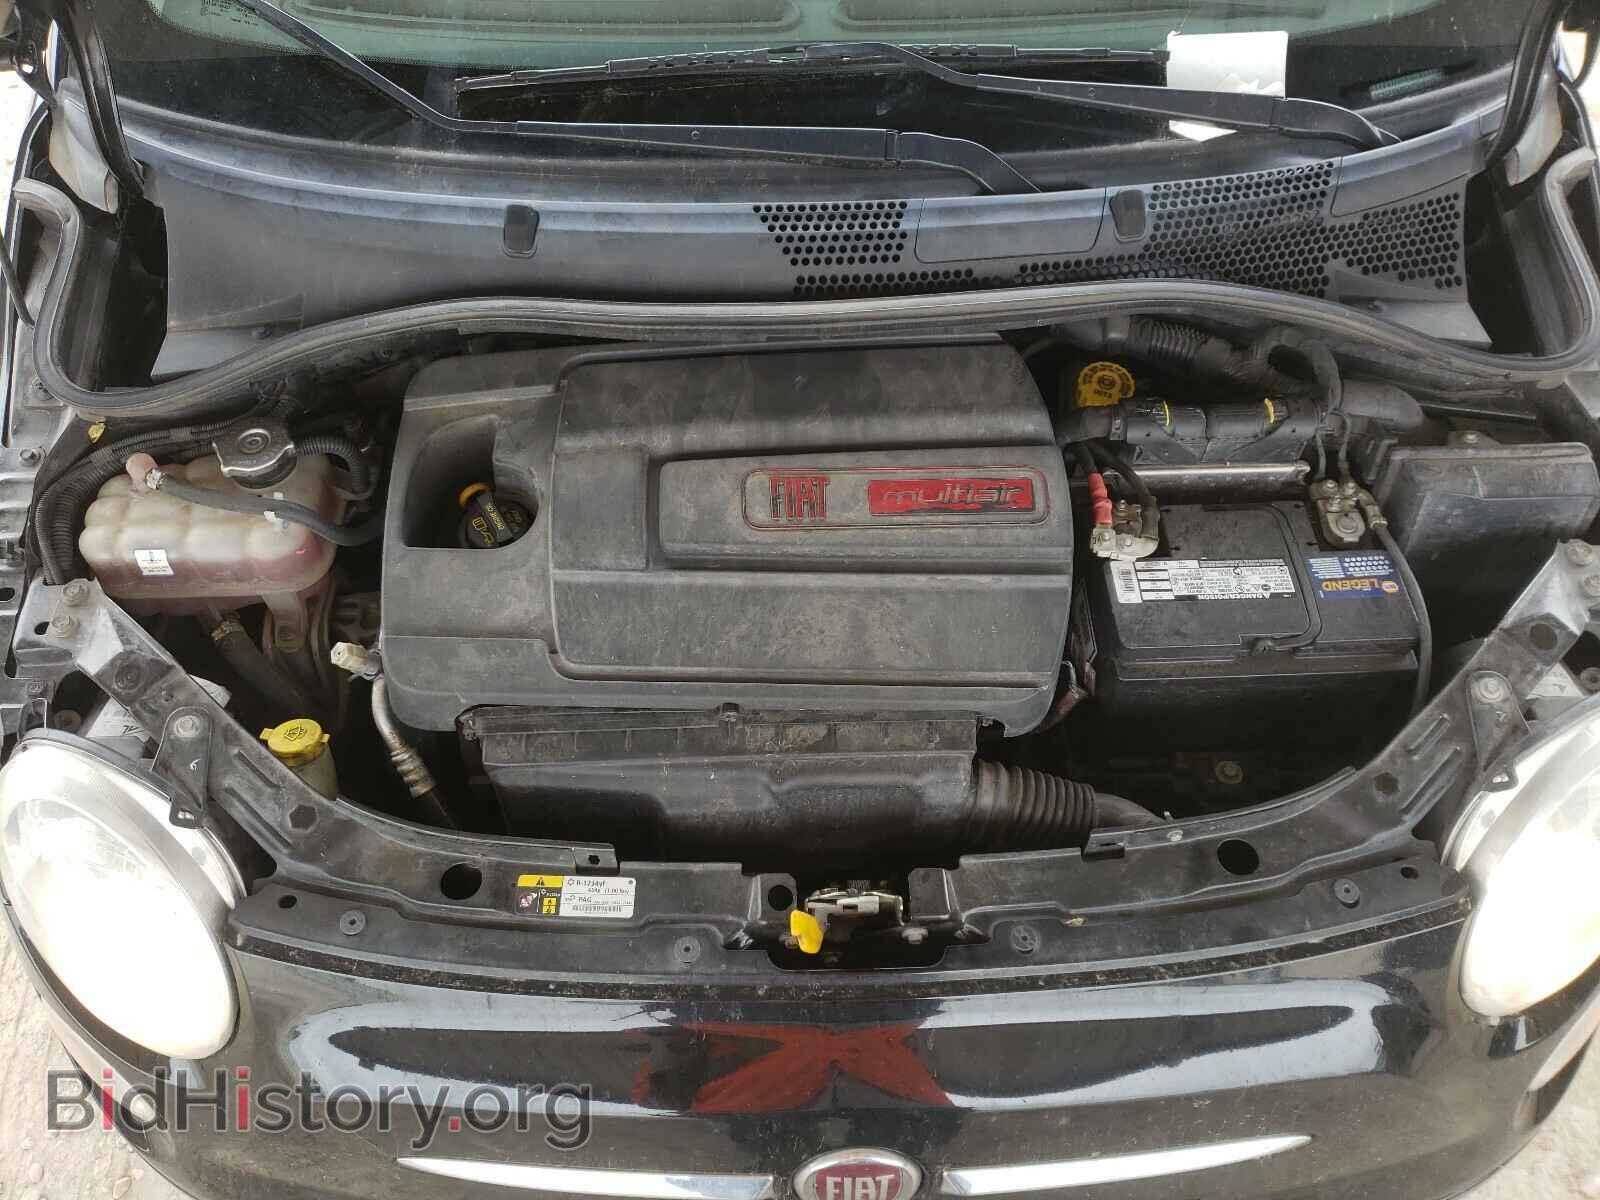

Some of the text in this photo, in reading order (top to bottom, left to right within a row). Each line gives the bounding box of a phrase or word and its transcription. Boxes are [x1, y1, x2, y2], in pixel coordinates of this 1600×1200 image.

[769, 476, 829, 520] FIAT
[883, 482, 1024, 505] multiair
[1322, 579, 1379, 591] LEGEND
[826, 1174, 895, 1200] FIAT
